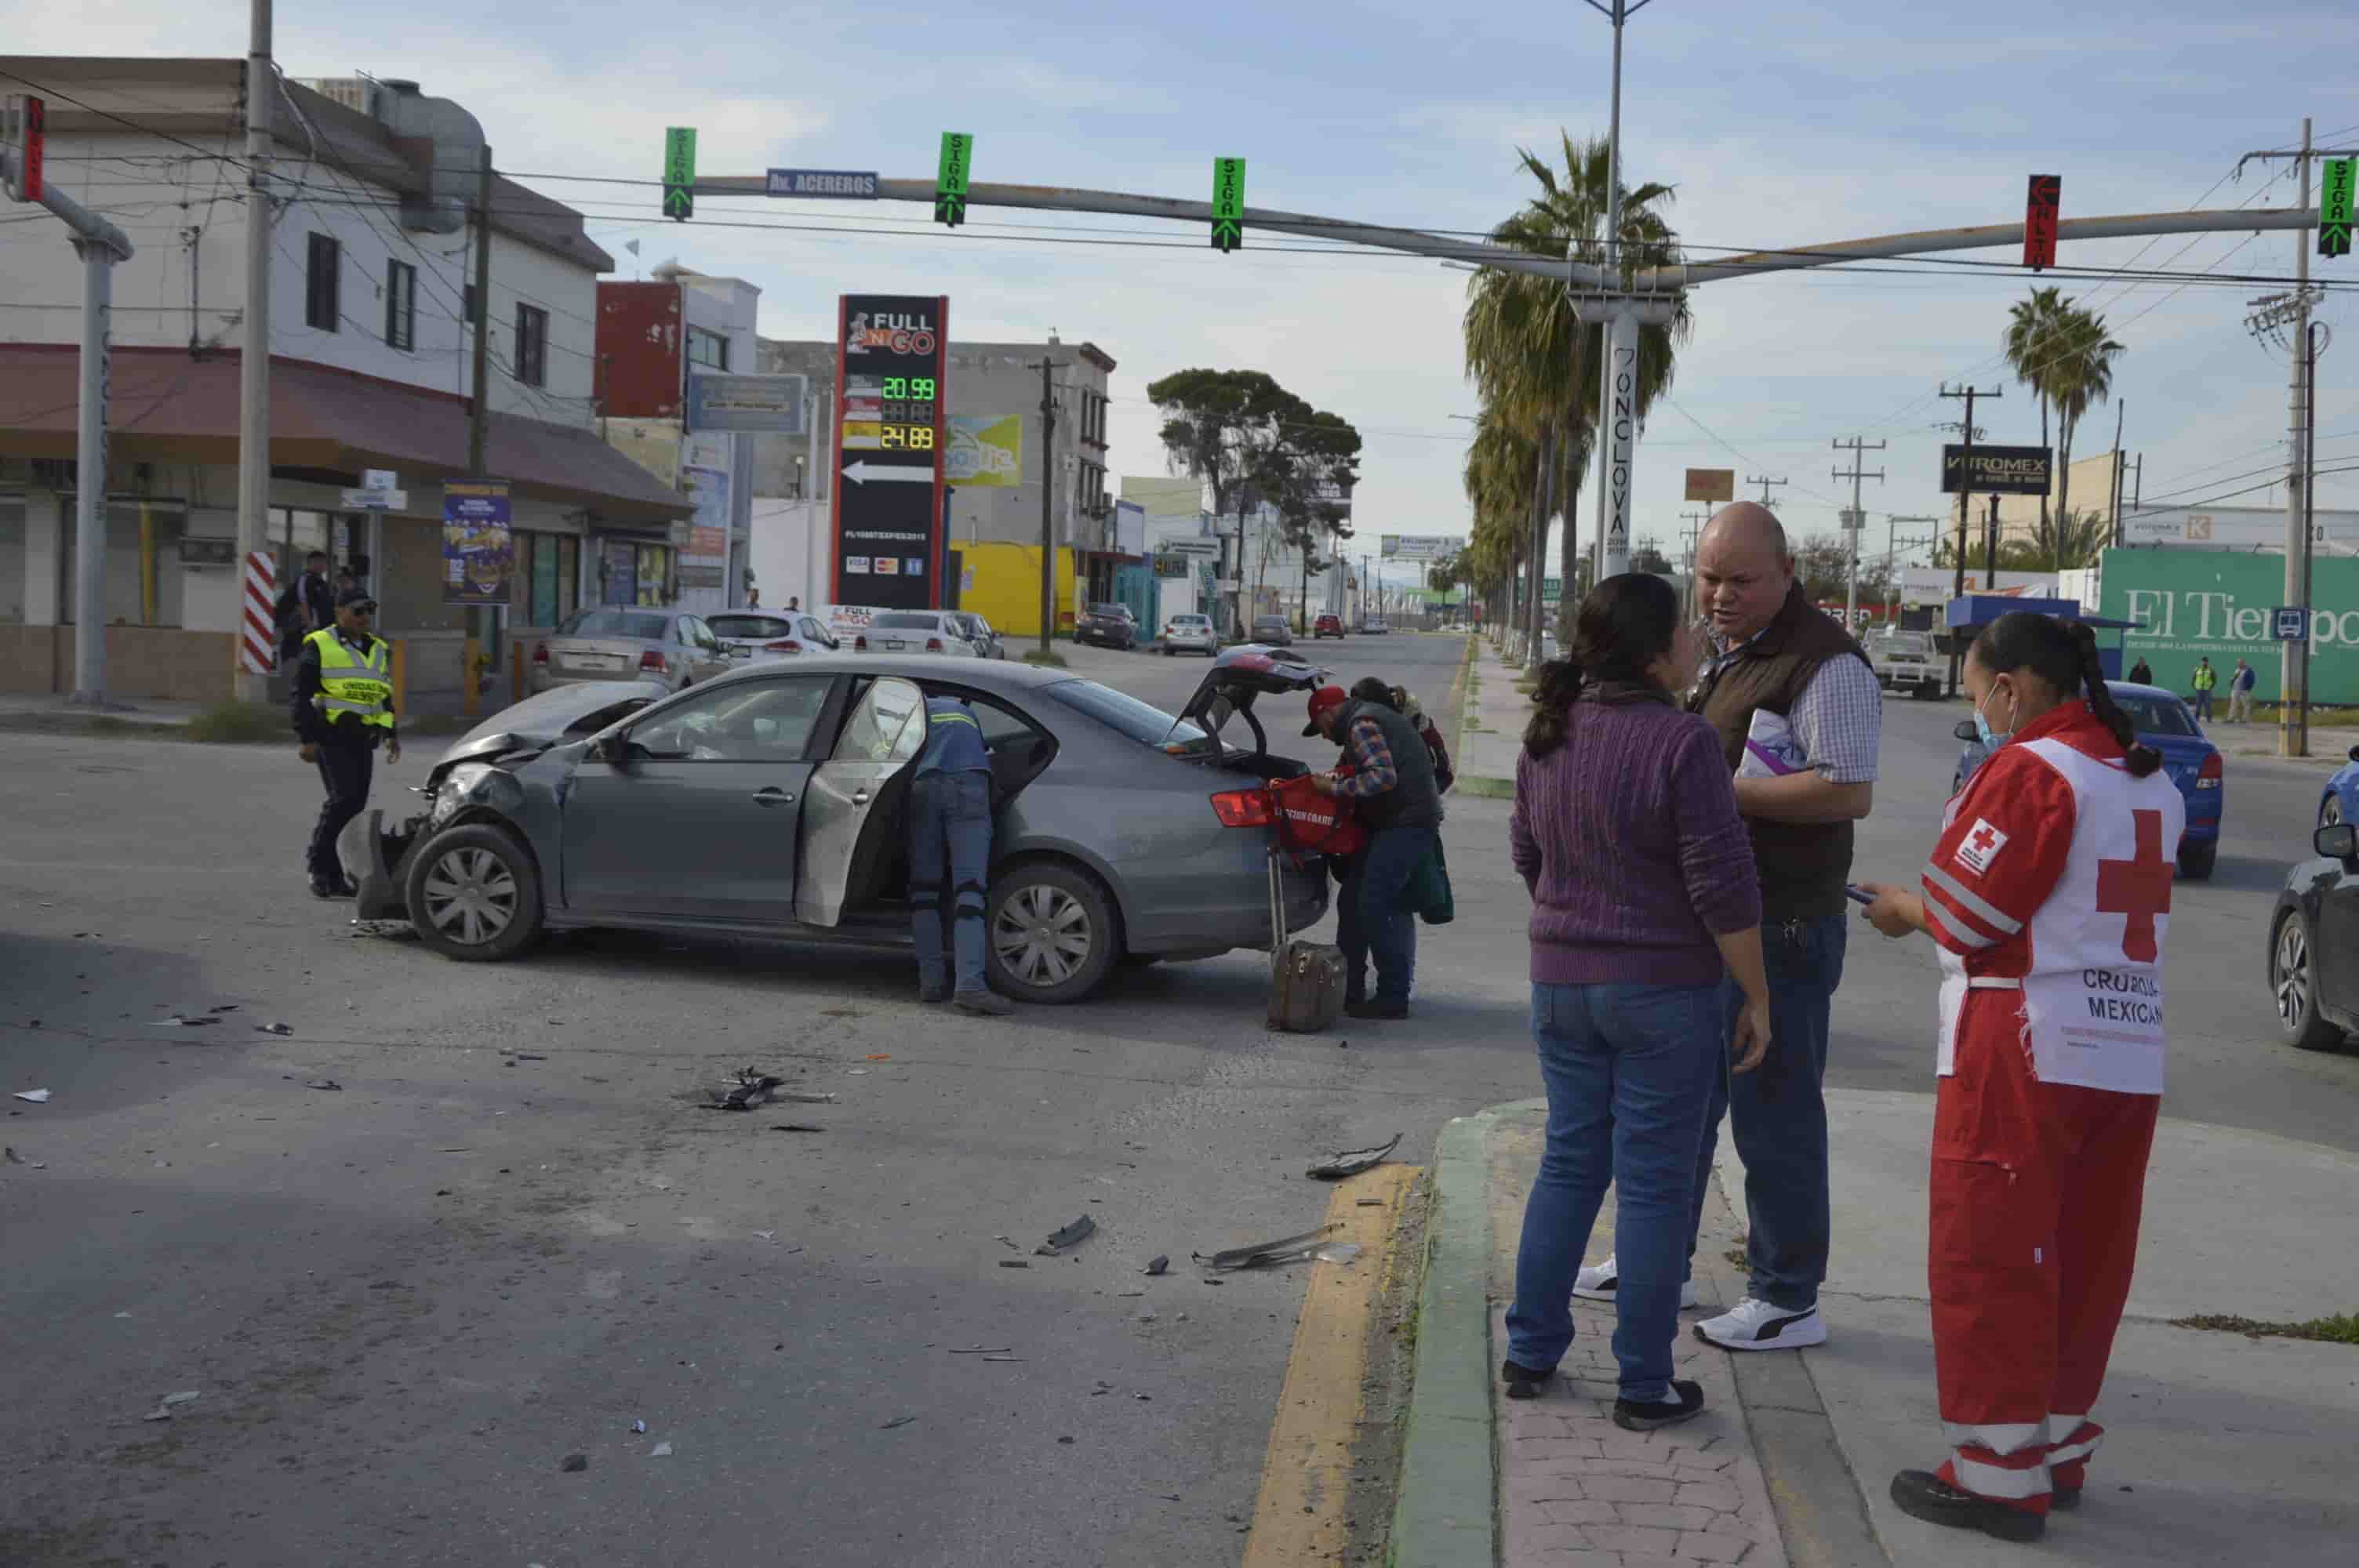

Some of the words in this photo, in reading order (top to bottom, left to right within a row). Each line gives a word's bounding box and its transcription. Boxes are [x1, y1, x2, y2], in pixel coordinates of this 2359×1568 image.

[673, 128, 688, 183] SIGA
[947, 133, 963, 191] SIGA
[795, 176, 875, 194] ACEREROS
[1221, 158, 1235, 215] SIGA
[2331, 160, 2347, 220] SIGA
[2034, 205, 2051, 267] ALTO
[874, 314, 934, 331] FULL
[891, 330, 935, 355] GO
[883, 378, 935, 400] 20.99
[881, 426, 933, 448] 24.89
[845, 607, 872, 615] FULL
[2125, 590, 2177, 639] El
[2185, 592, 2359, 656] Tiepo
[2083, 968, 2130, 993] CRU
[2088, 996, 2164, 1025] MEXICAN
